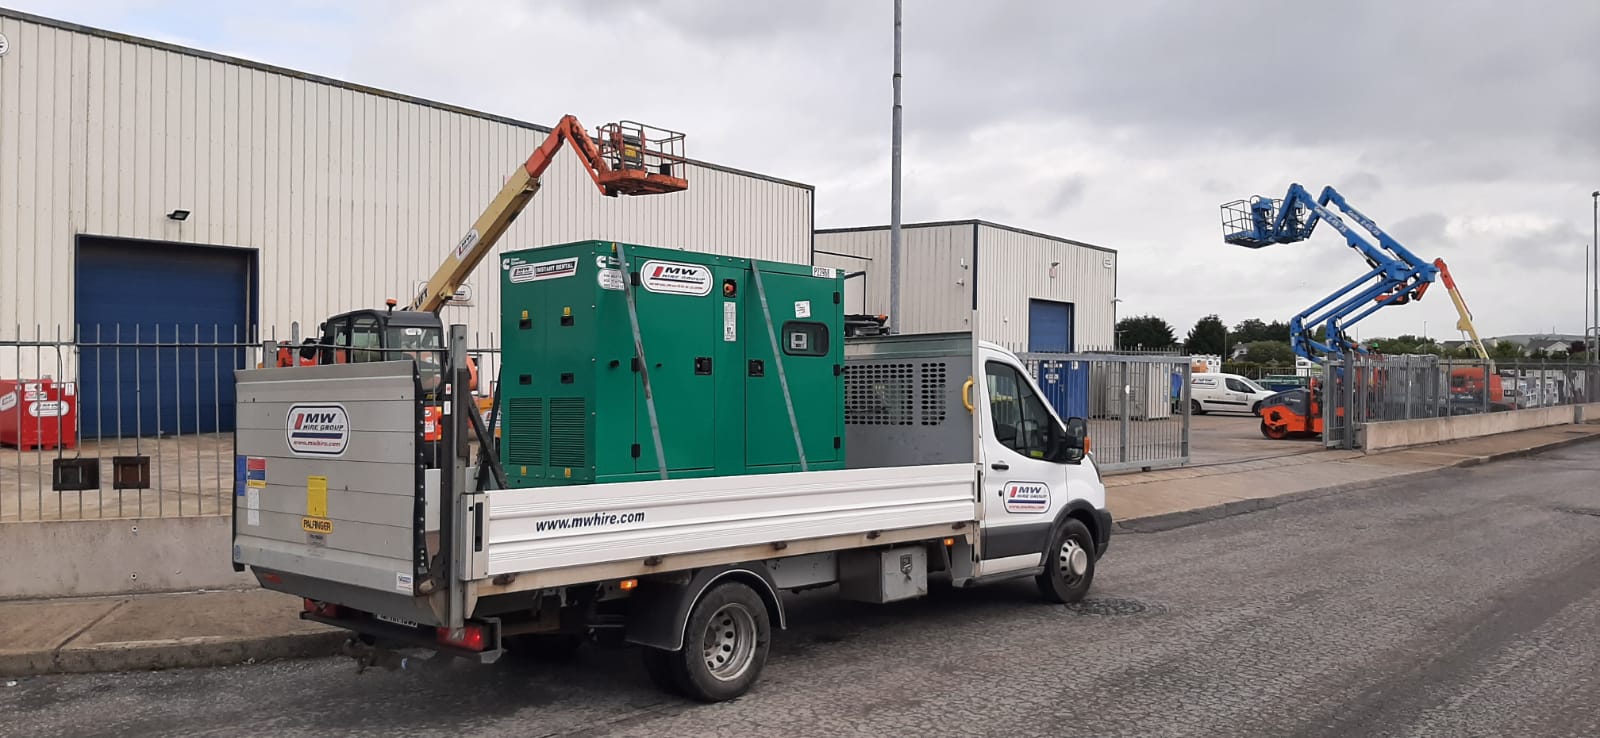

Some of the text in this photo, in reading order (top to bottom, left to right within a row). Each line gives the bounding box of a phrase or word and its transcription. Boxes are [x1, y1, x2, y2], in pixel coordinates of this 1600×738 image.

[665, 267, 698, 276] MW
[305, 413, 337, 424] MW
[320, 424, 344, 432] GROUP
[536, 511, 645, 532] www.mwhire.com
